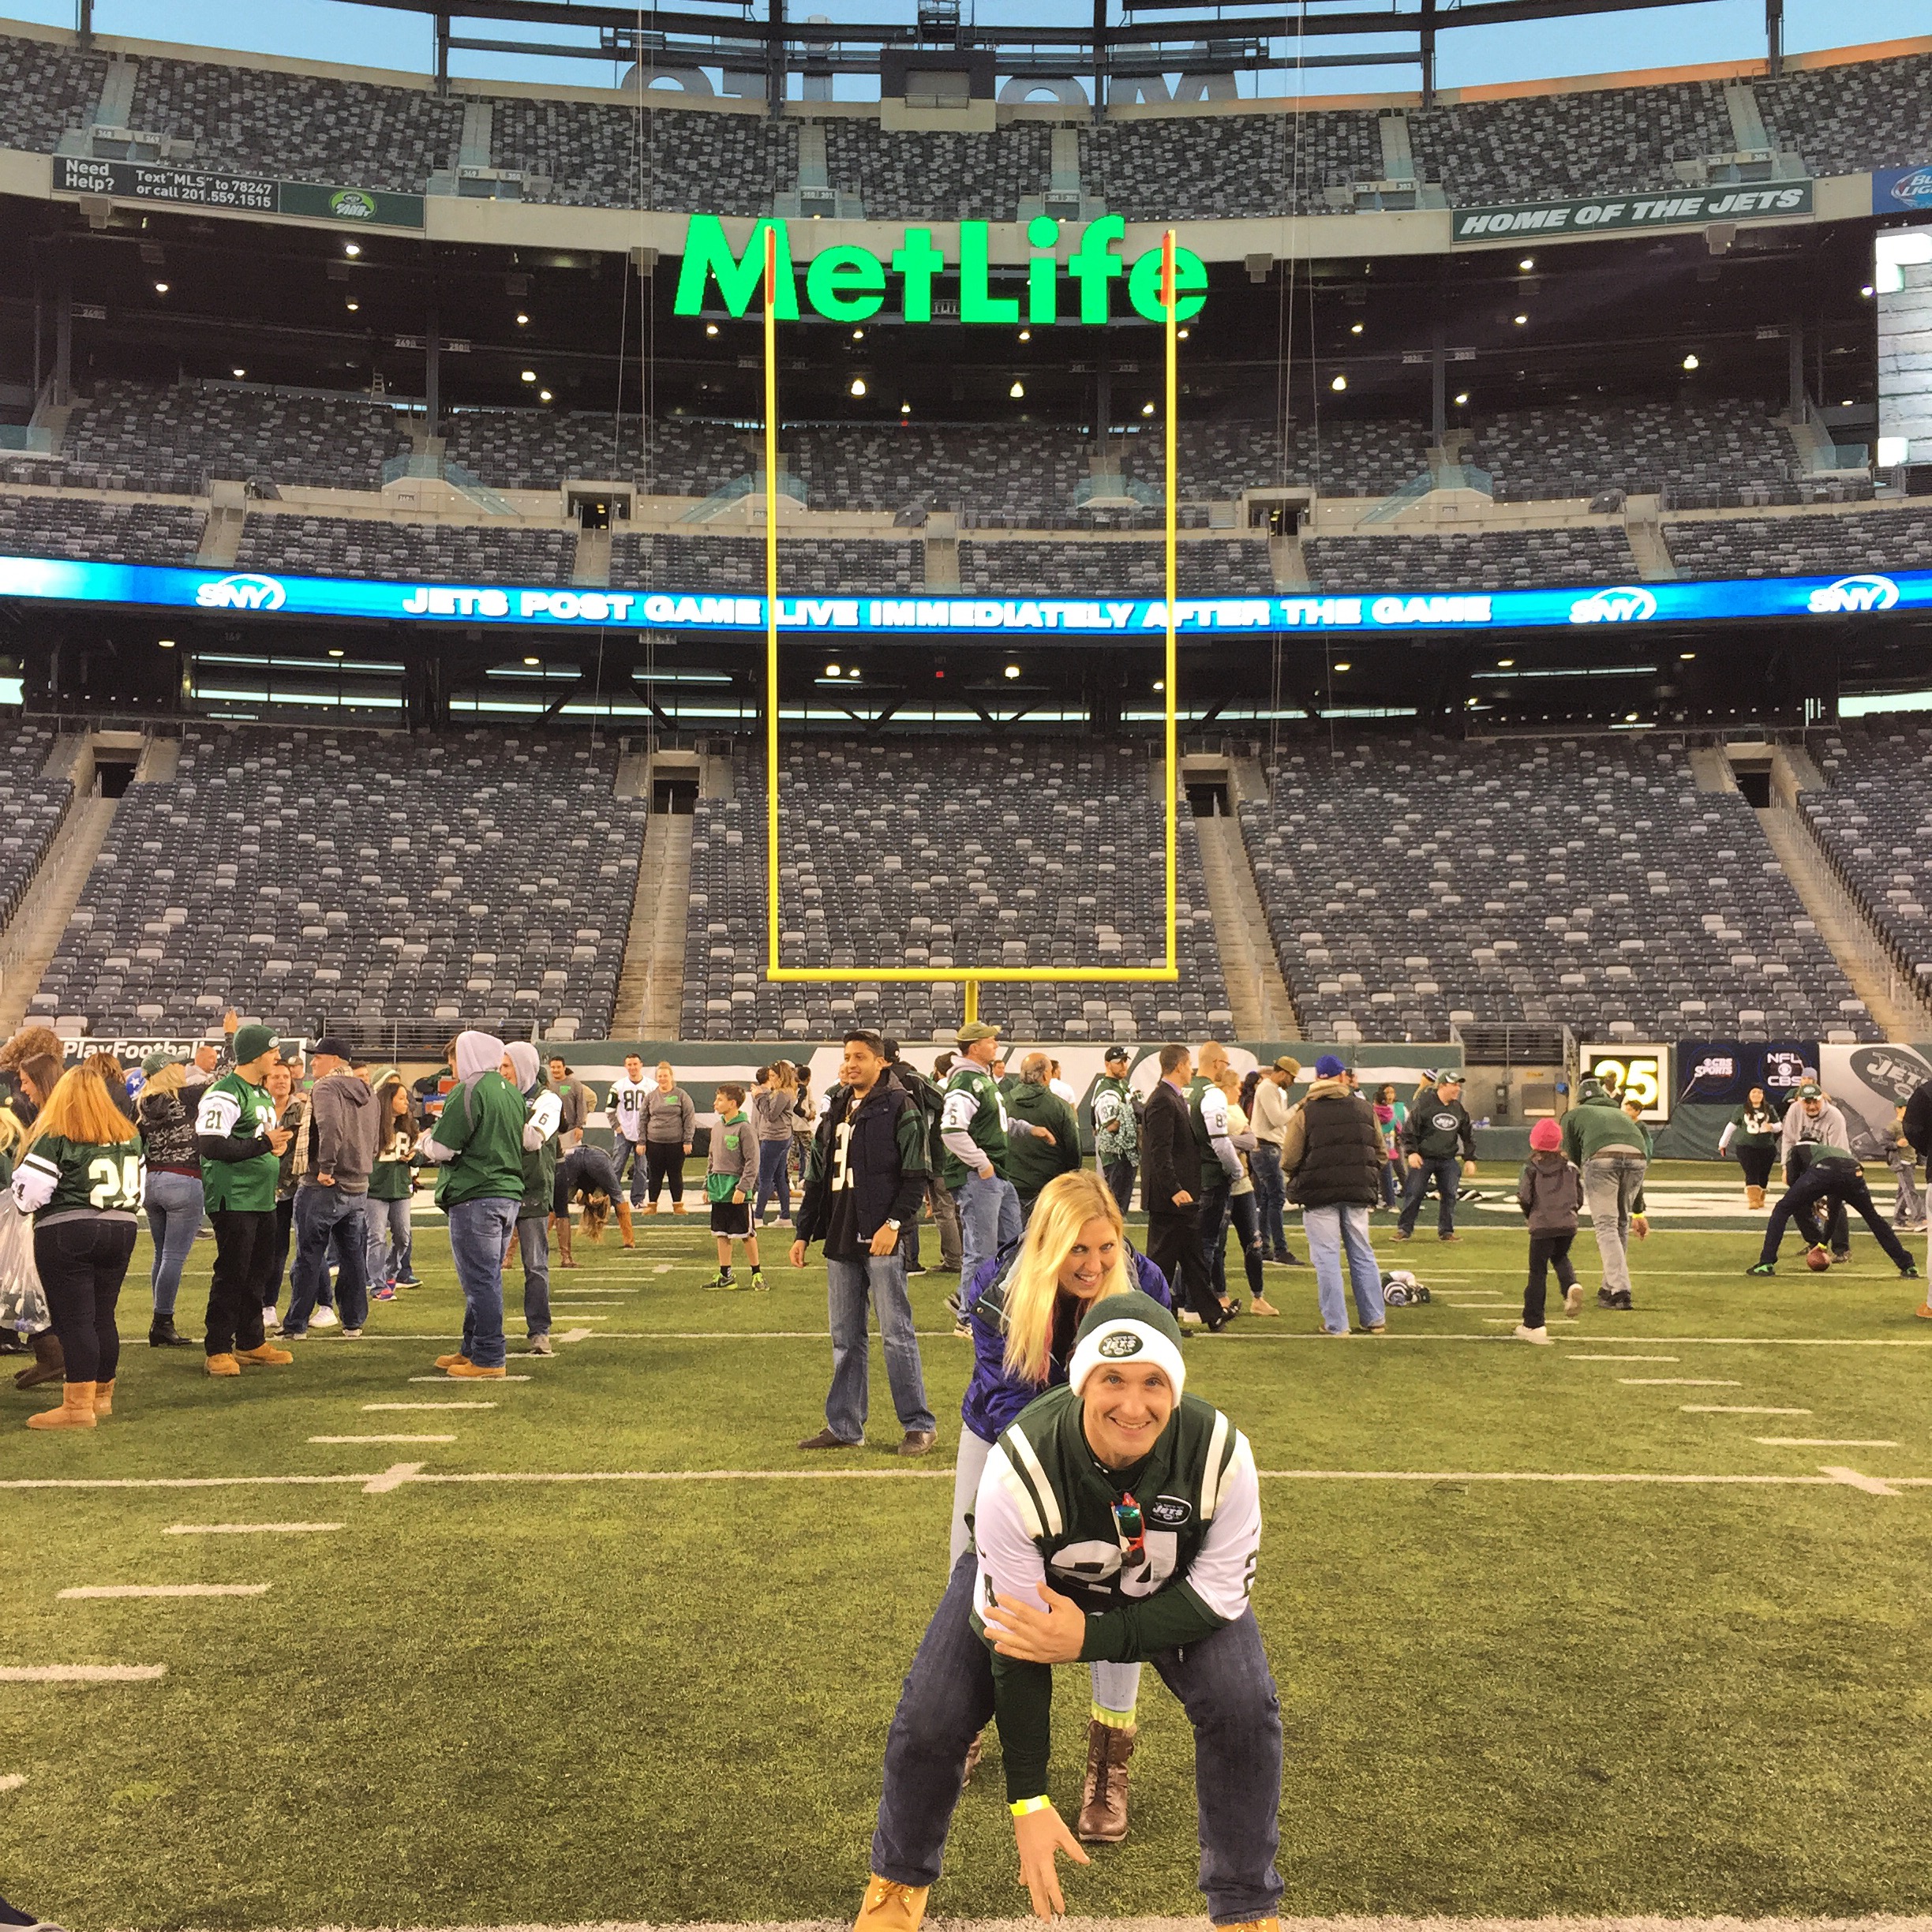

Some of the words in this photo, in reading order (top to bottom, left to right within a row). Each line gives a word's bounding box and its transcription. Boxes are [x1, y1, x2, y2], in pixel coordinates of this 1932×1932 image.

[66, 159, 109, 176] Need
[66, 174, 114, 192] Help?
[136, 170, 166, 183] Text
[215, 179, 229, 191] to
[231, 180, 271, 195] 78247
[1901, 185, 1932, 197] LIG
[1911, 175, 1932, 185] BU
[137, 185, 149, 195] or
[153, 185, 178, 197] call
[182, 189, 271, 208] 201.559.1515
[1459, 208, 1571, 234] HOME
[1574, 203, 1627, 224] OF
[1631, 197, 1705, 221] THE
[1708, 188, 1804, 214] JETS
[673, 214, 1208, 324] MetLife
[195, 576, 282, 610] SNY
[1807, 578, 1896, 612] SNY
[402, 587, 508, 619] JETS
[519, 590, 634, 620] POST
[646, 595, 761, 626] GAME
[775, 600, 859, 626] LIVE
[869, 600, 1136, 629] IMMEDIATELY
[1141, 600, 1271, 628] AFTER
[1279, 599, 1362, 627] THE
[1372, 595, 1492, 624] GAME
[1568, 590, 1652, 623] SNY
[1767, 1052, 1802, 1063] NFL
[1694, 1065, 1733, 1077] SPORTS
[1767, 1076, 1802, 1087] CBS
[623, 1089, 646, 1111] 80
[204, 1110, 223, 1129] 21
[538, 1113, 549, 1125] 6
[88, 1155, 140, 1209] 24
